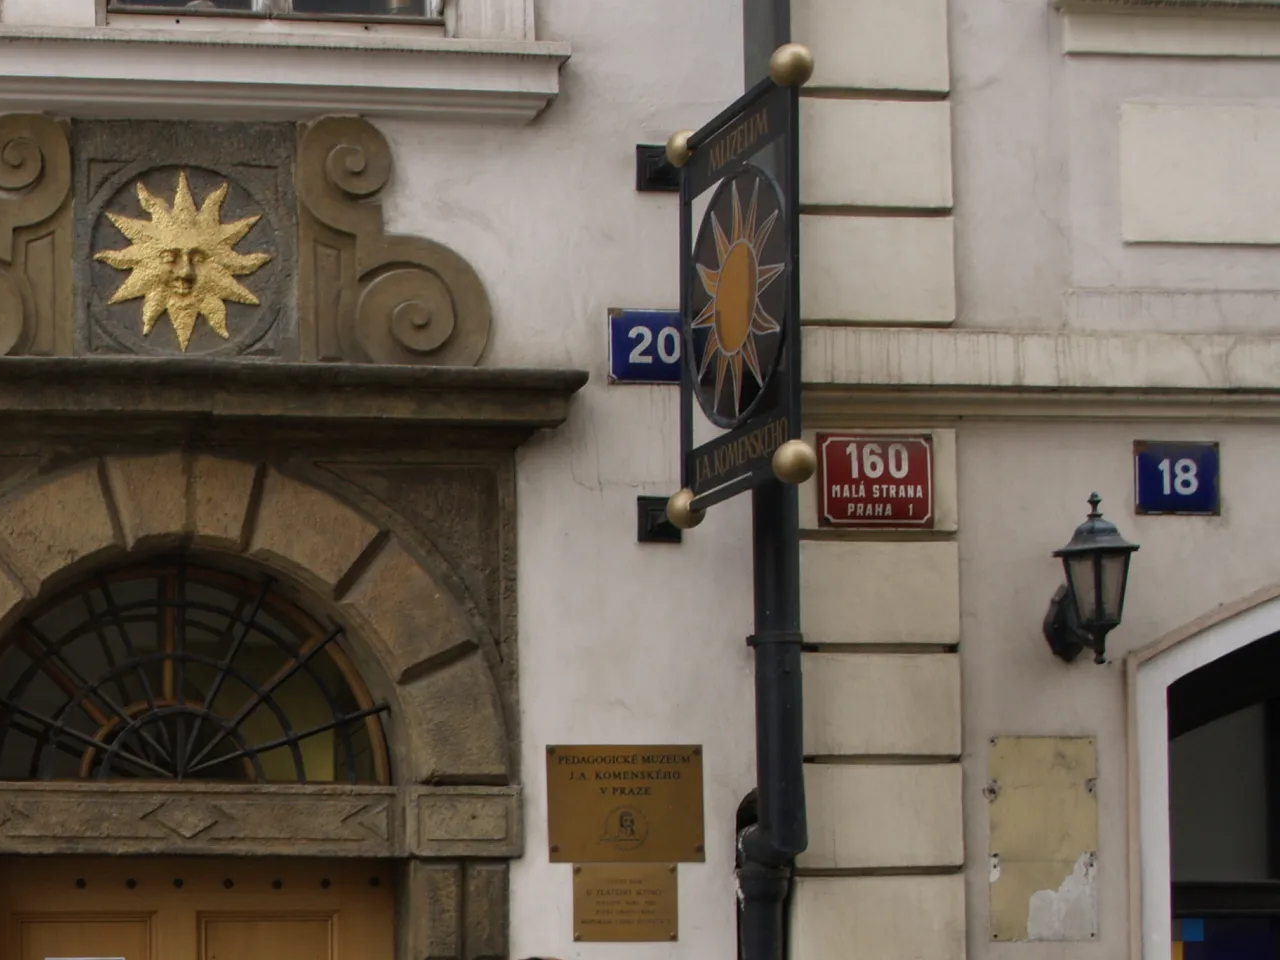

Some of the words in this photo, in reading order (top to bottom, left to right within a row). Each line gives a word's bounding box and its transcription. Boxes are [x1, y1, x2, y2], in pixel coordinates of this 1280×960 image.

[708, 107, 768, 177] MUZEUM
[627, 325, 681, 364] 20
[845, 442, 910, 480] 160
[1158, 457, 1200, 496] 18
[831, 481, 866, 499] MALÁ
[872, 484, 924, 499] STRANA
[847, 503, 893, 517] PRAHA
[908, 503, 914, 517] 1
[557, 754, 638, 765] PEDAGOGICKÉ
[642, 755, 691, 764] MUZEUM
[595, 769, 681, 781] KOMENSKÉHO
[600, 787, 608, 796] V
[612, 787, 652, 796] PRAZE
